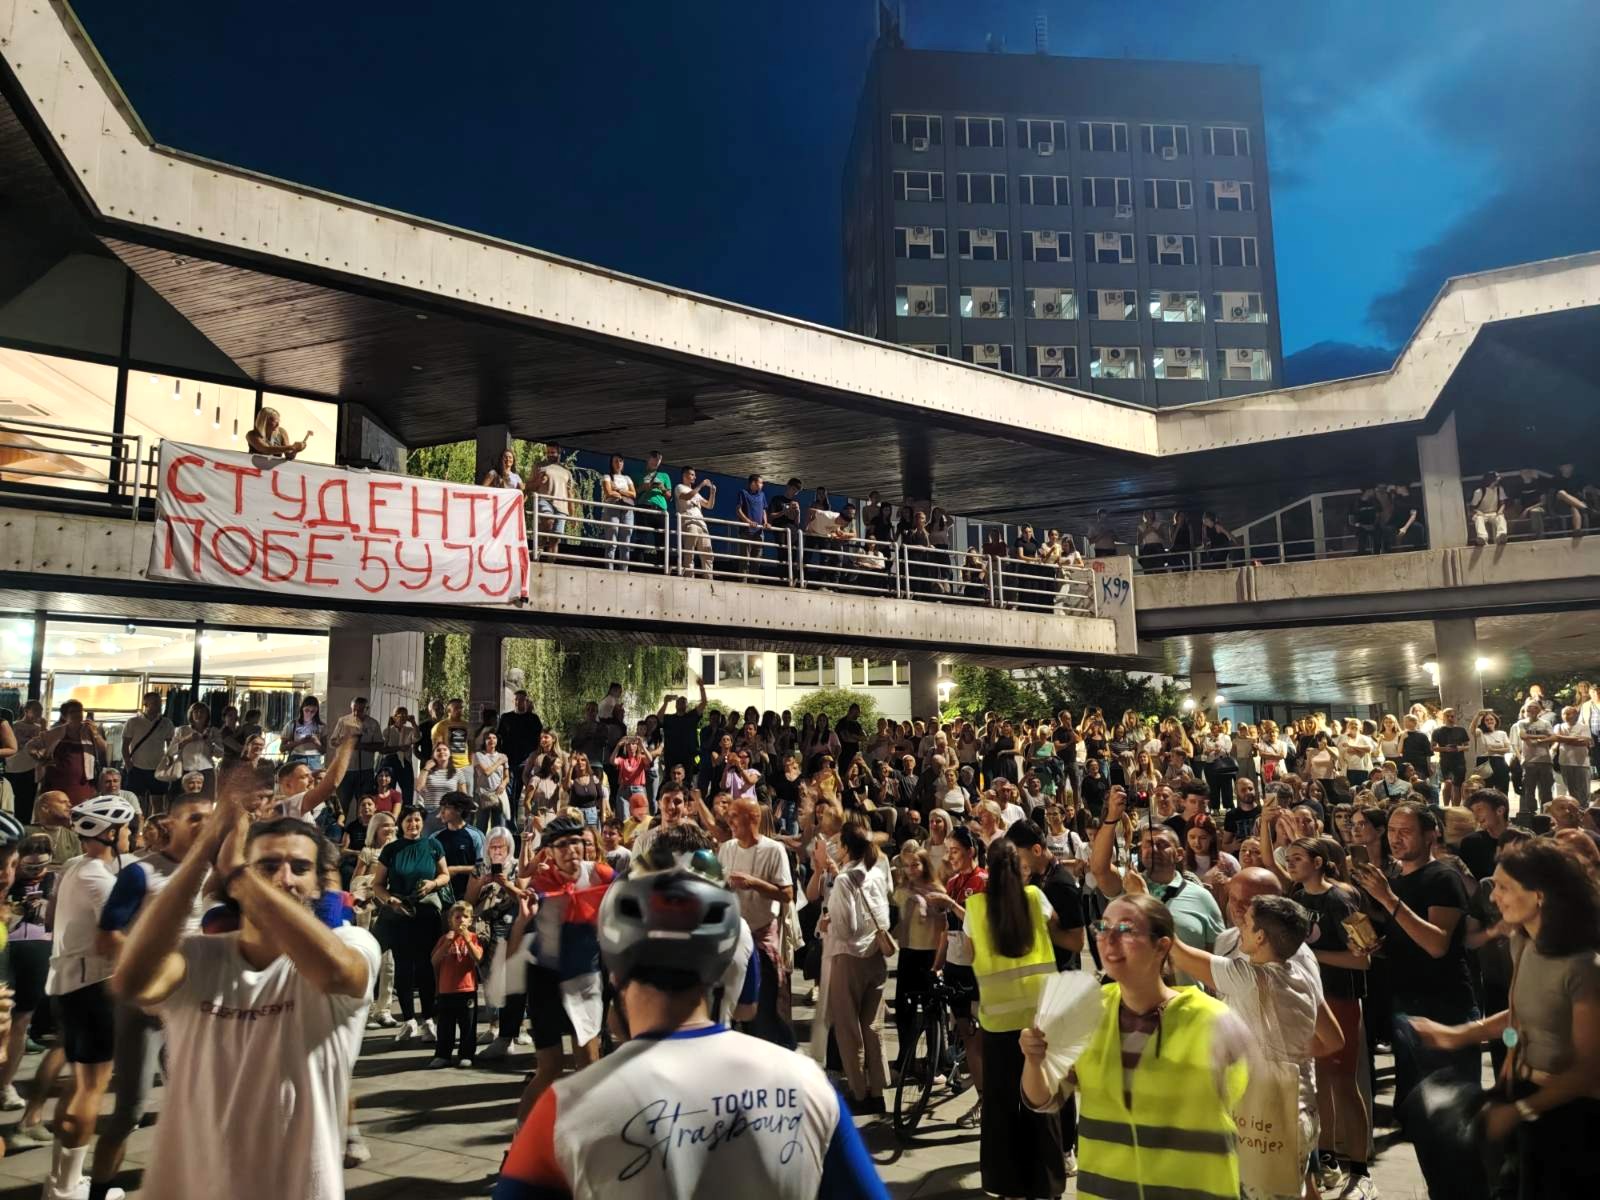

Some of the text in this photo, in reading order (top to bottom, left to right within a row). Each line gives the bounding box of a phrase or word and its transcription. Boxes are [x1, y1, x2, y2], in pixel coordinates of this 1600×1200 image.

[166, 454, 525, 543] СТУДЕНТИ
[164, 515, 530, 599] ПОБЕЂУЈУ!
[1102, 576, 1130, 606] K99
[712, 1088, 797, 1116] TOUR DE
[1251, 1115, 1272, 1133] ide
[618, 1099, 804, 1181] Strasbourg
[1239, 1135, 1284, 1154] vanje?
